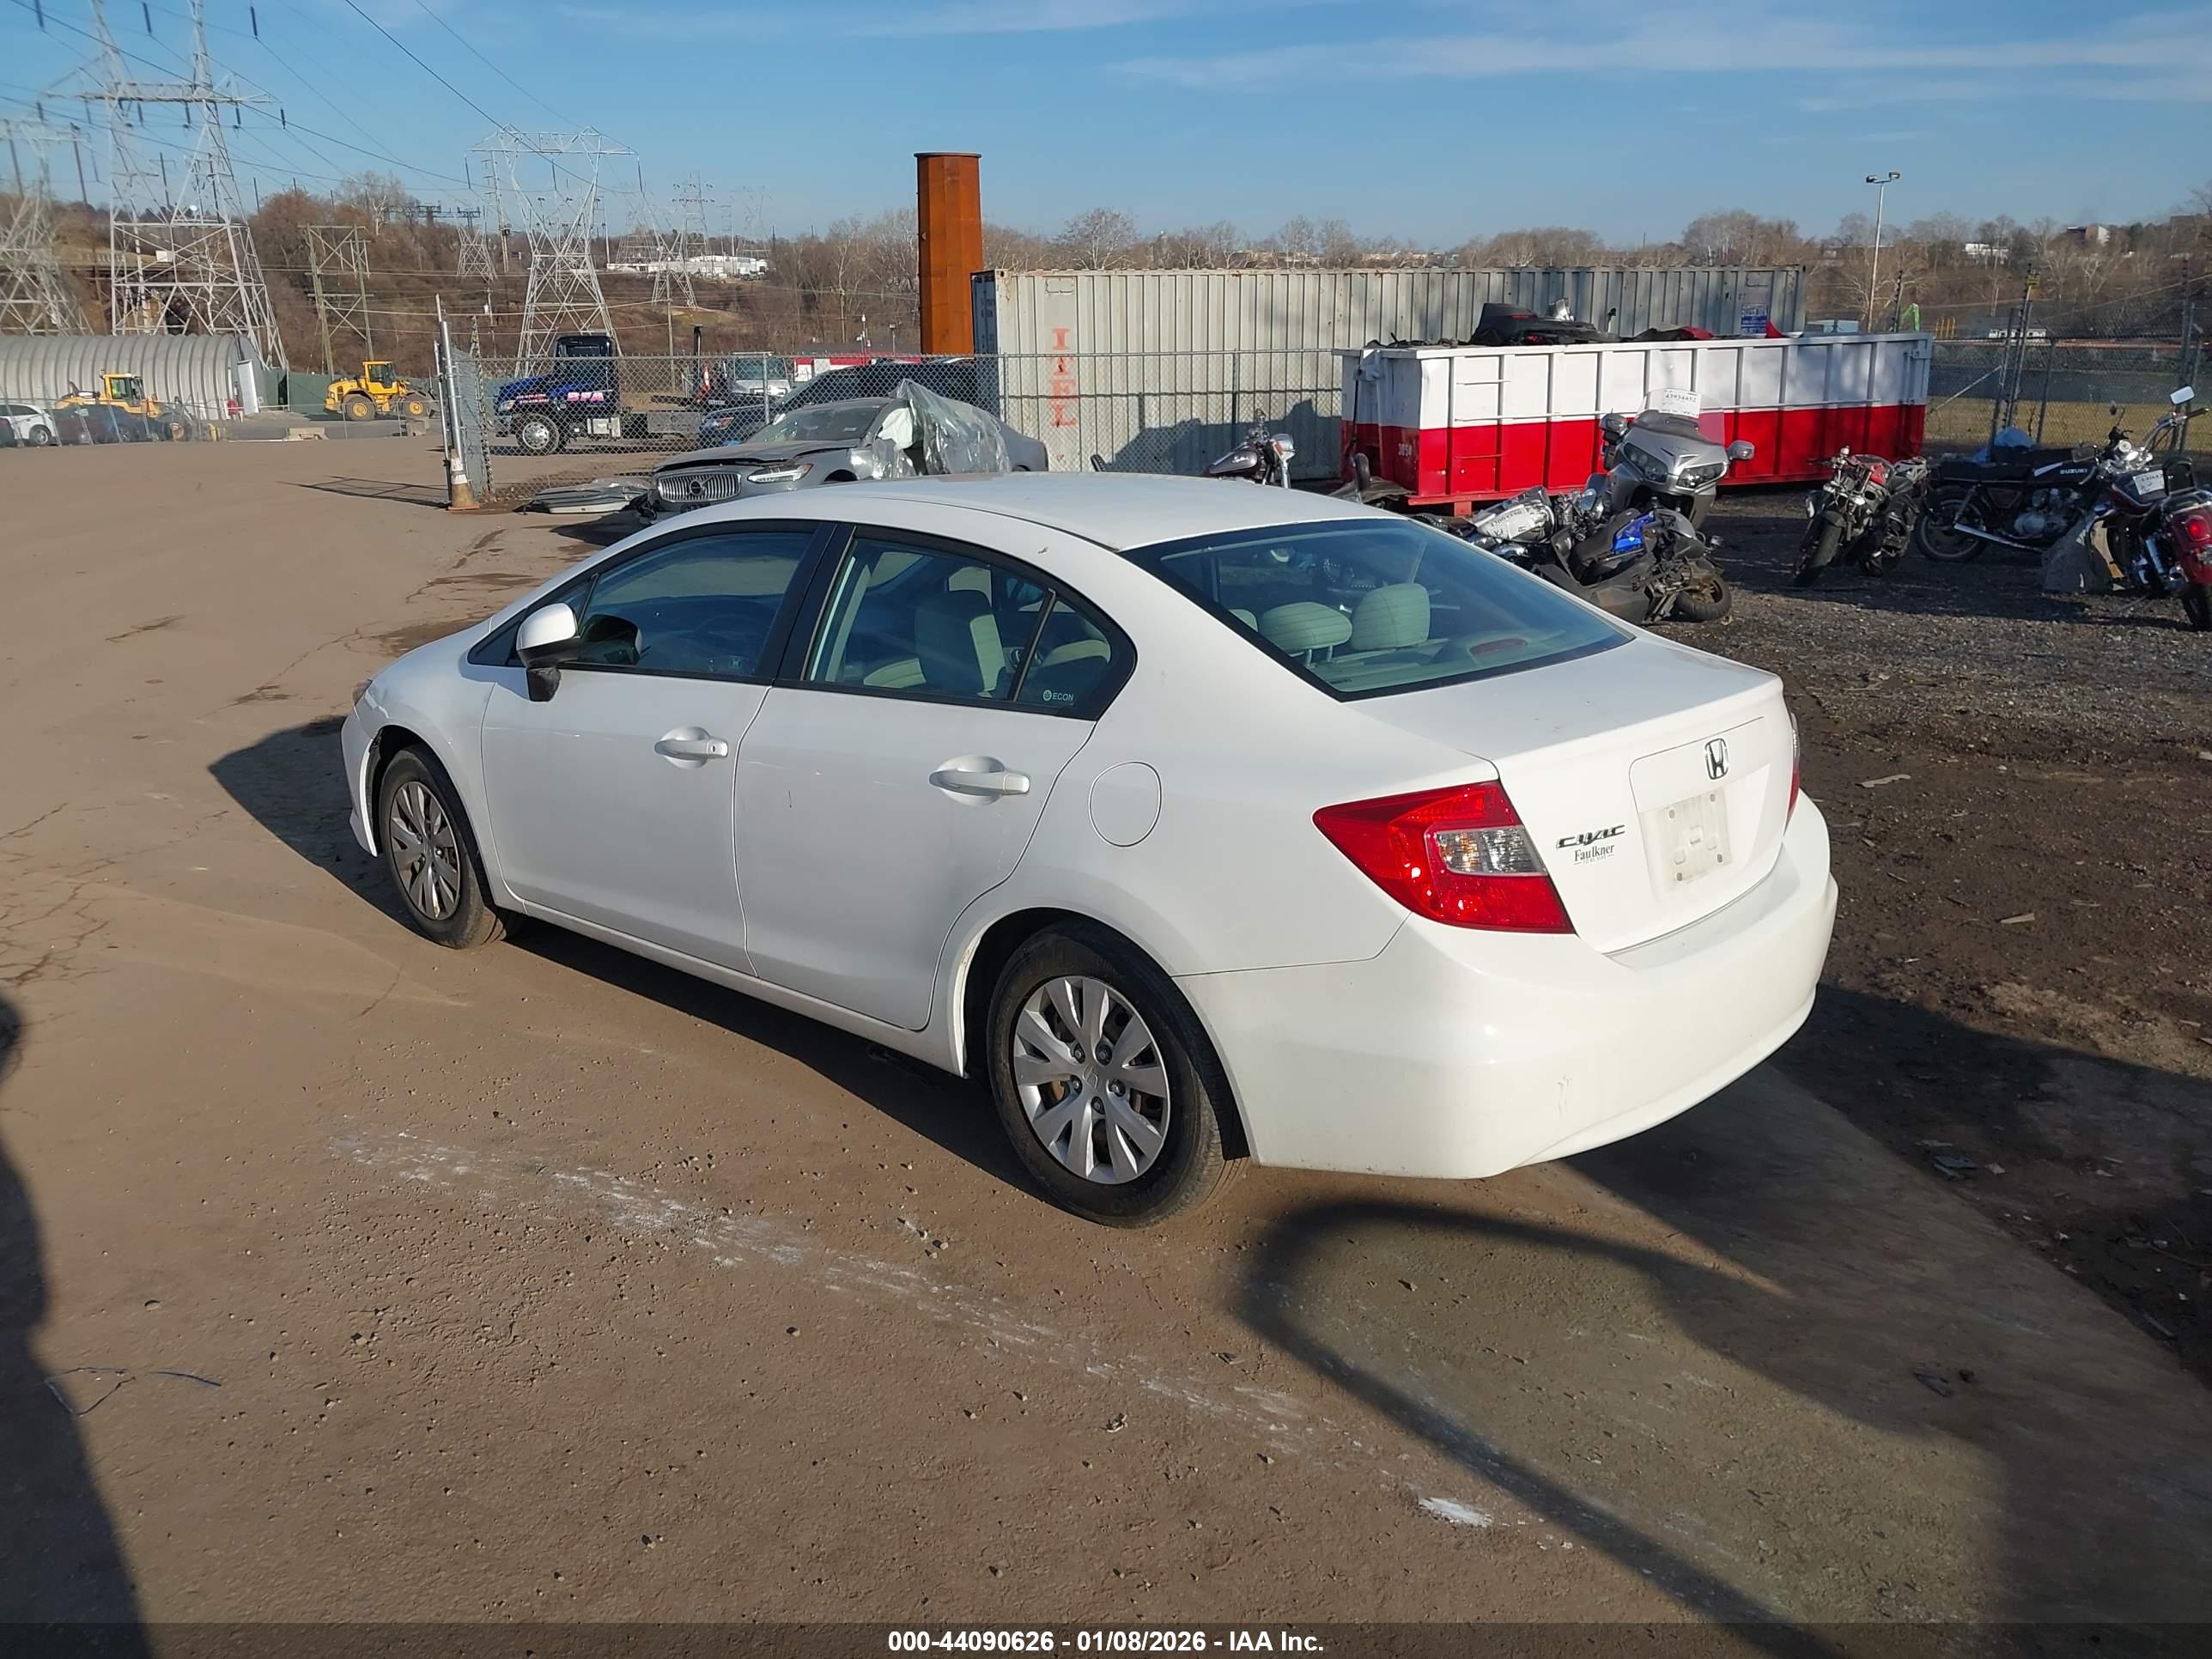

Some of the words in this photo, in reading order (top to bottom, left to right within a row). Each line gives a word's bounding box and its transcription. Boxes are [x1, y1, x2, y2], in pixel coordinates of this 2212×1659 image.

[1052, 692, 1074, 702] ECON
[1556, 824, 1626, 848] CIVIC
[1574, 844, 1615, 861] Faulkner
